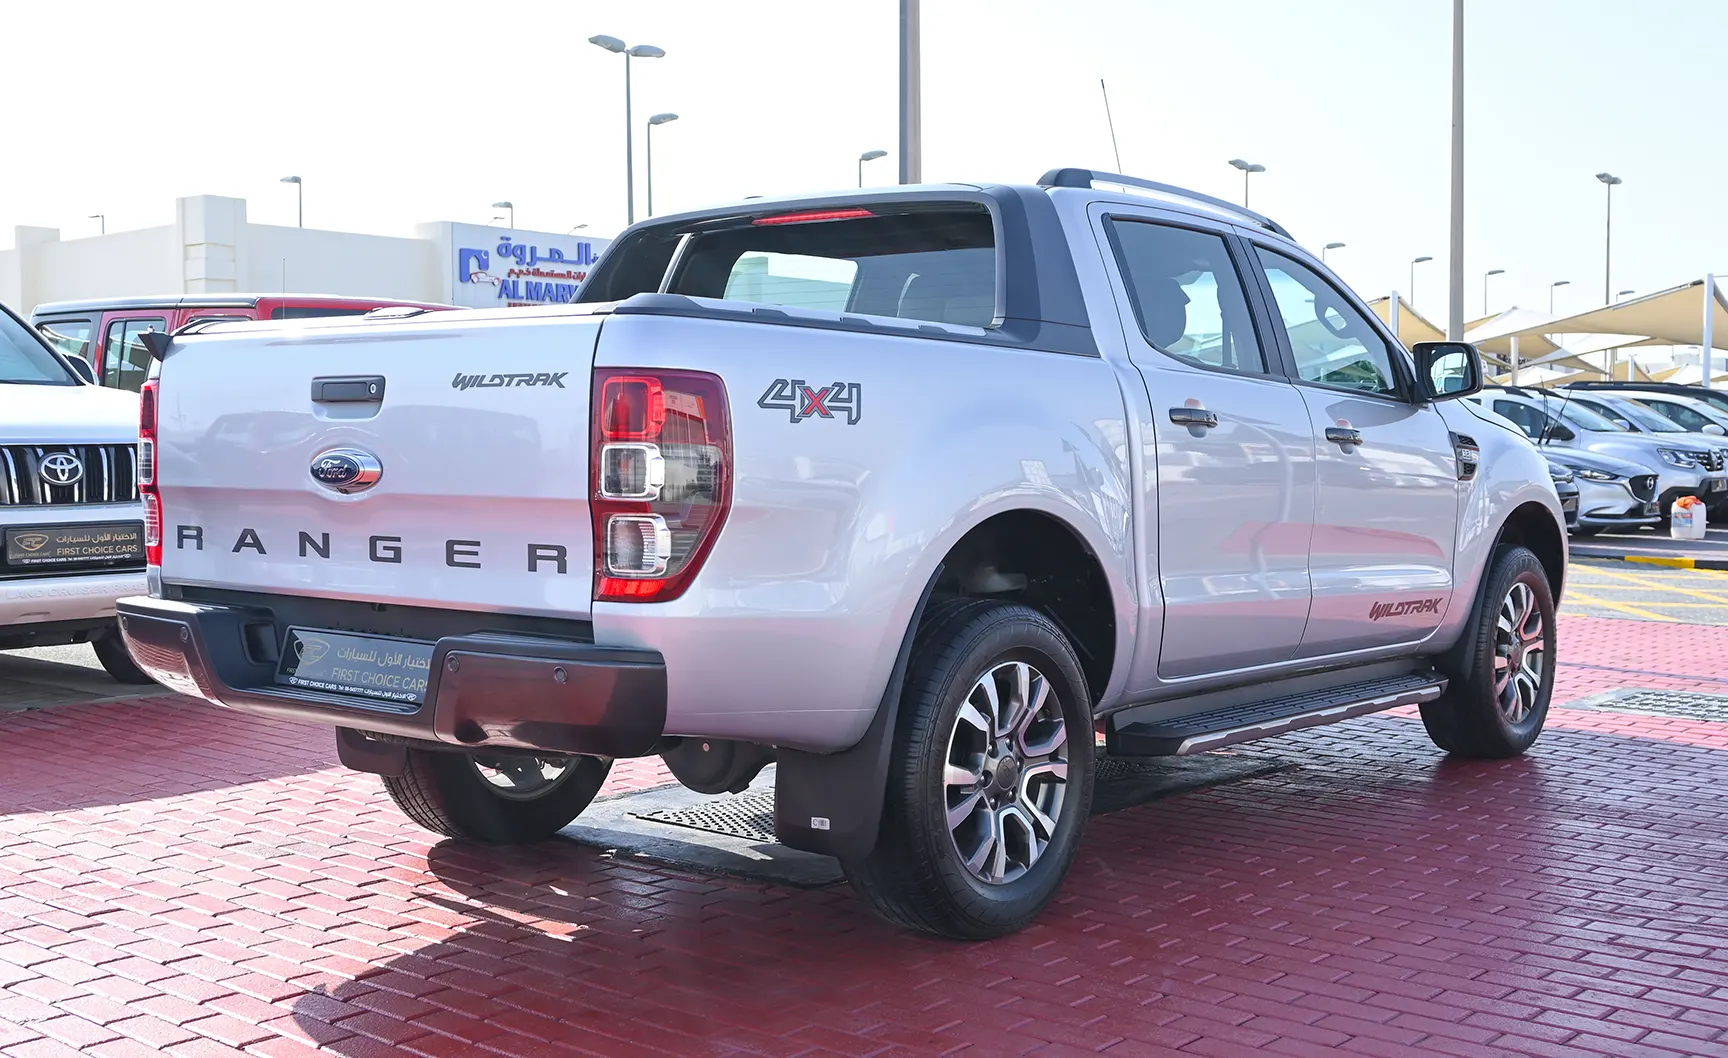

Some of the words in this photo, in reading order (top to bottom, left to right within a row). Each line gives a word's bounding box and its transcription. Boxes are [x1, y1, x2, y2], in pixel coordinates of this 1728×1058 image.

[497, 236, 591, 266] المروة
[498, 279, 524, 299] AL
[451, 372, 569, 391] WILDTRAK
[318, 459, 348, 478] Ford
[56, 534, 90, 544] للسيارات
[92, 532, 111, 543] الأول
[112, 532, 137, 542] الاختيار
[56, 547, 80, 555] FIRST
[82, 545, 114, 554] CHOICE
[115, 544, 138, 553] CARS
[177, 524, 567, 574] RANGER
[1369, 597, 1443, 621] WILDTRAK
[337, 647, 377, 662] للسيارات
[377, 651, 403, 668] الأول
[331, 667, 360, 682] FIRST
[361, 672, 401, 688] CHOICE
